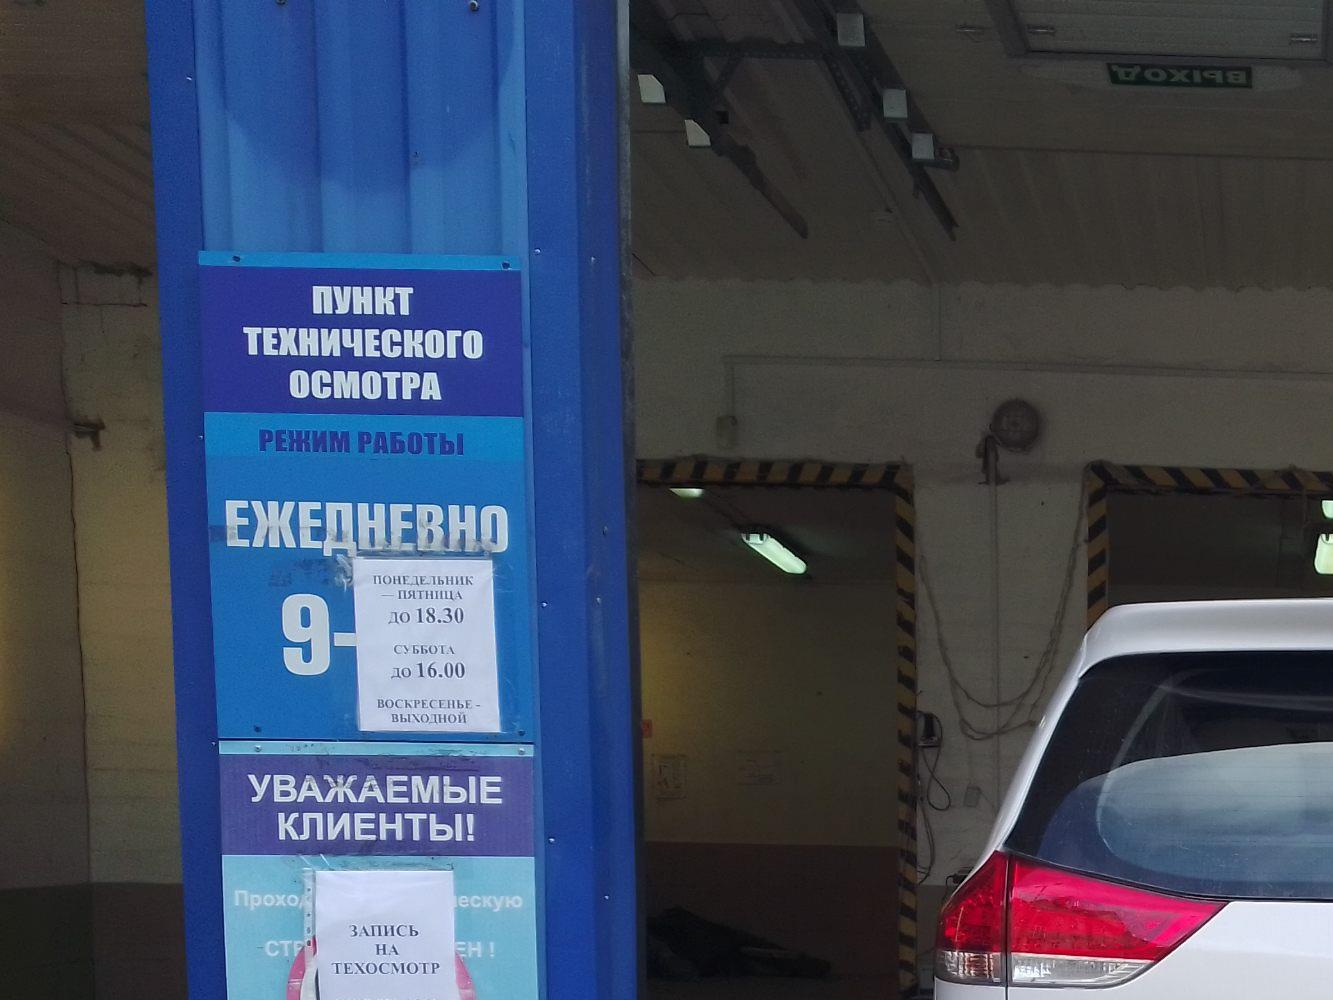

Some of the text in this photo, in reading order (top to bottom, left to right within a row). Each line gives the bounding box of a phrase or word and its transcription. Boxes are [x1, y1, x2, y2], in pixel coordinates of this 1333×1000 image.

[1111, 64, 1248, 84] ВЫХОД
[312, 285, 414, 315] ПУНКТ
[242, 326, 484, 359] ТЕХНИЧЕСКОГО
[289, 370, 442, 401] ОСМОТРА
[259, 429, 465, 456] РЕЖИМ РАБОТЫ
[225, 500, 508, 557] ЕЖЕДНЕВНО
[373, 575, 474, 586] ПОНЕДЕЛЬНИК
[398, 589, 463, 601] ПЯТНИЦА
[388, 607, 464, 624] до 18.30
[393, 644, 455, 655] СУББОТА
[391, 662, 465, 679] до 16.00
[377, 698, 473, 709] ВОСКРЕСЕНЬЕ
[391, 712, 467, 724] ВЫХОДНОЙ
[247, 773, 503, 804] УВАЖАЕМЫЕ
[277, 811, 475, 841] КЛИЕНТЫ!
[350, 924, 419, 937] ЗАПИСЬ
[375, 943, 399, 956] НА
[332, 962, 440, 975] ТЕХОСМОТР
